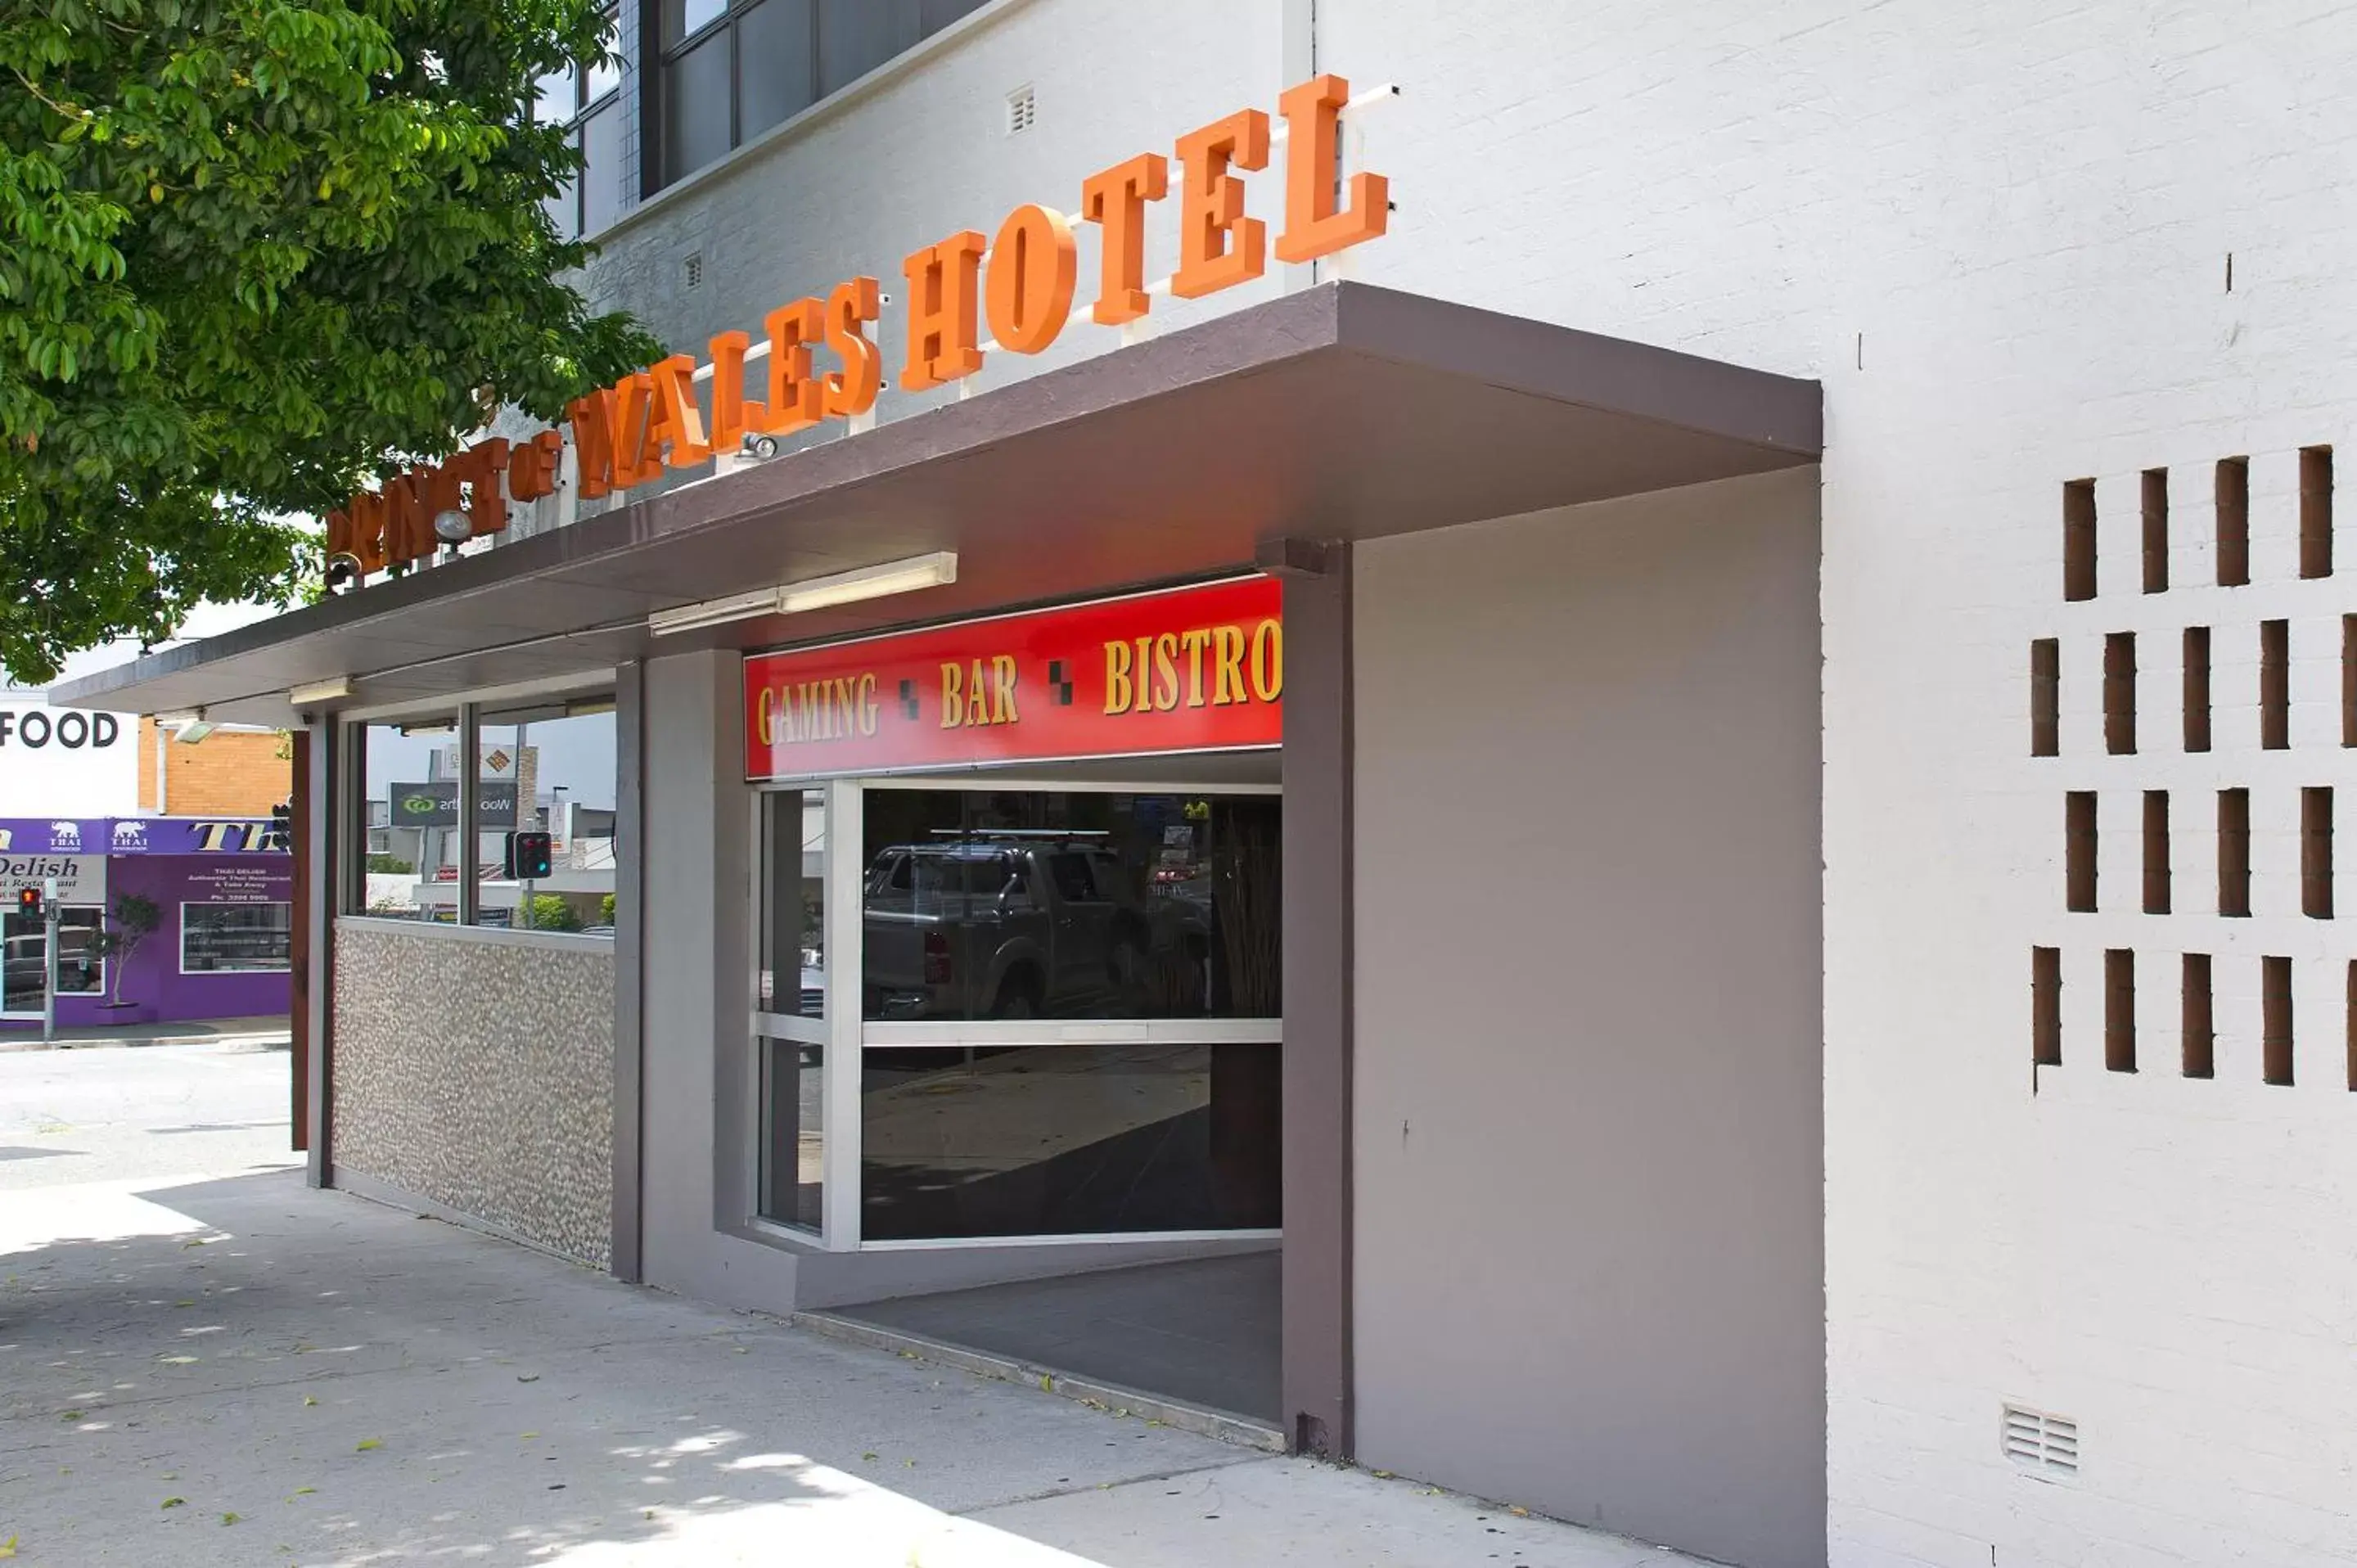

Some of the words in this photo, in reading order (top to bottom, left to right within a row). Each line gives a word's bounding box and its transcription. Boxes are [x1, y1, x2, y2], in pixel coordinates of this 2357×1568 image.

[566, 276, 881, 499] WALES
[900, 74, 1388, 392] HOTEL
[758, 672, 878, 746] GAMING
[940, 655, 1018, 729] BAR
[1103, 619, 1283, 714] BISTRO
[0, 710, 119, 749] FOOD
[50, 838, 82, 846] THAI
[112, 838, 148, 846] THAI
